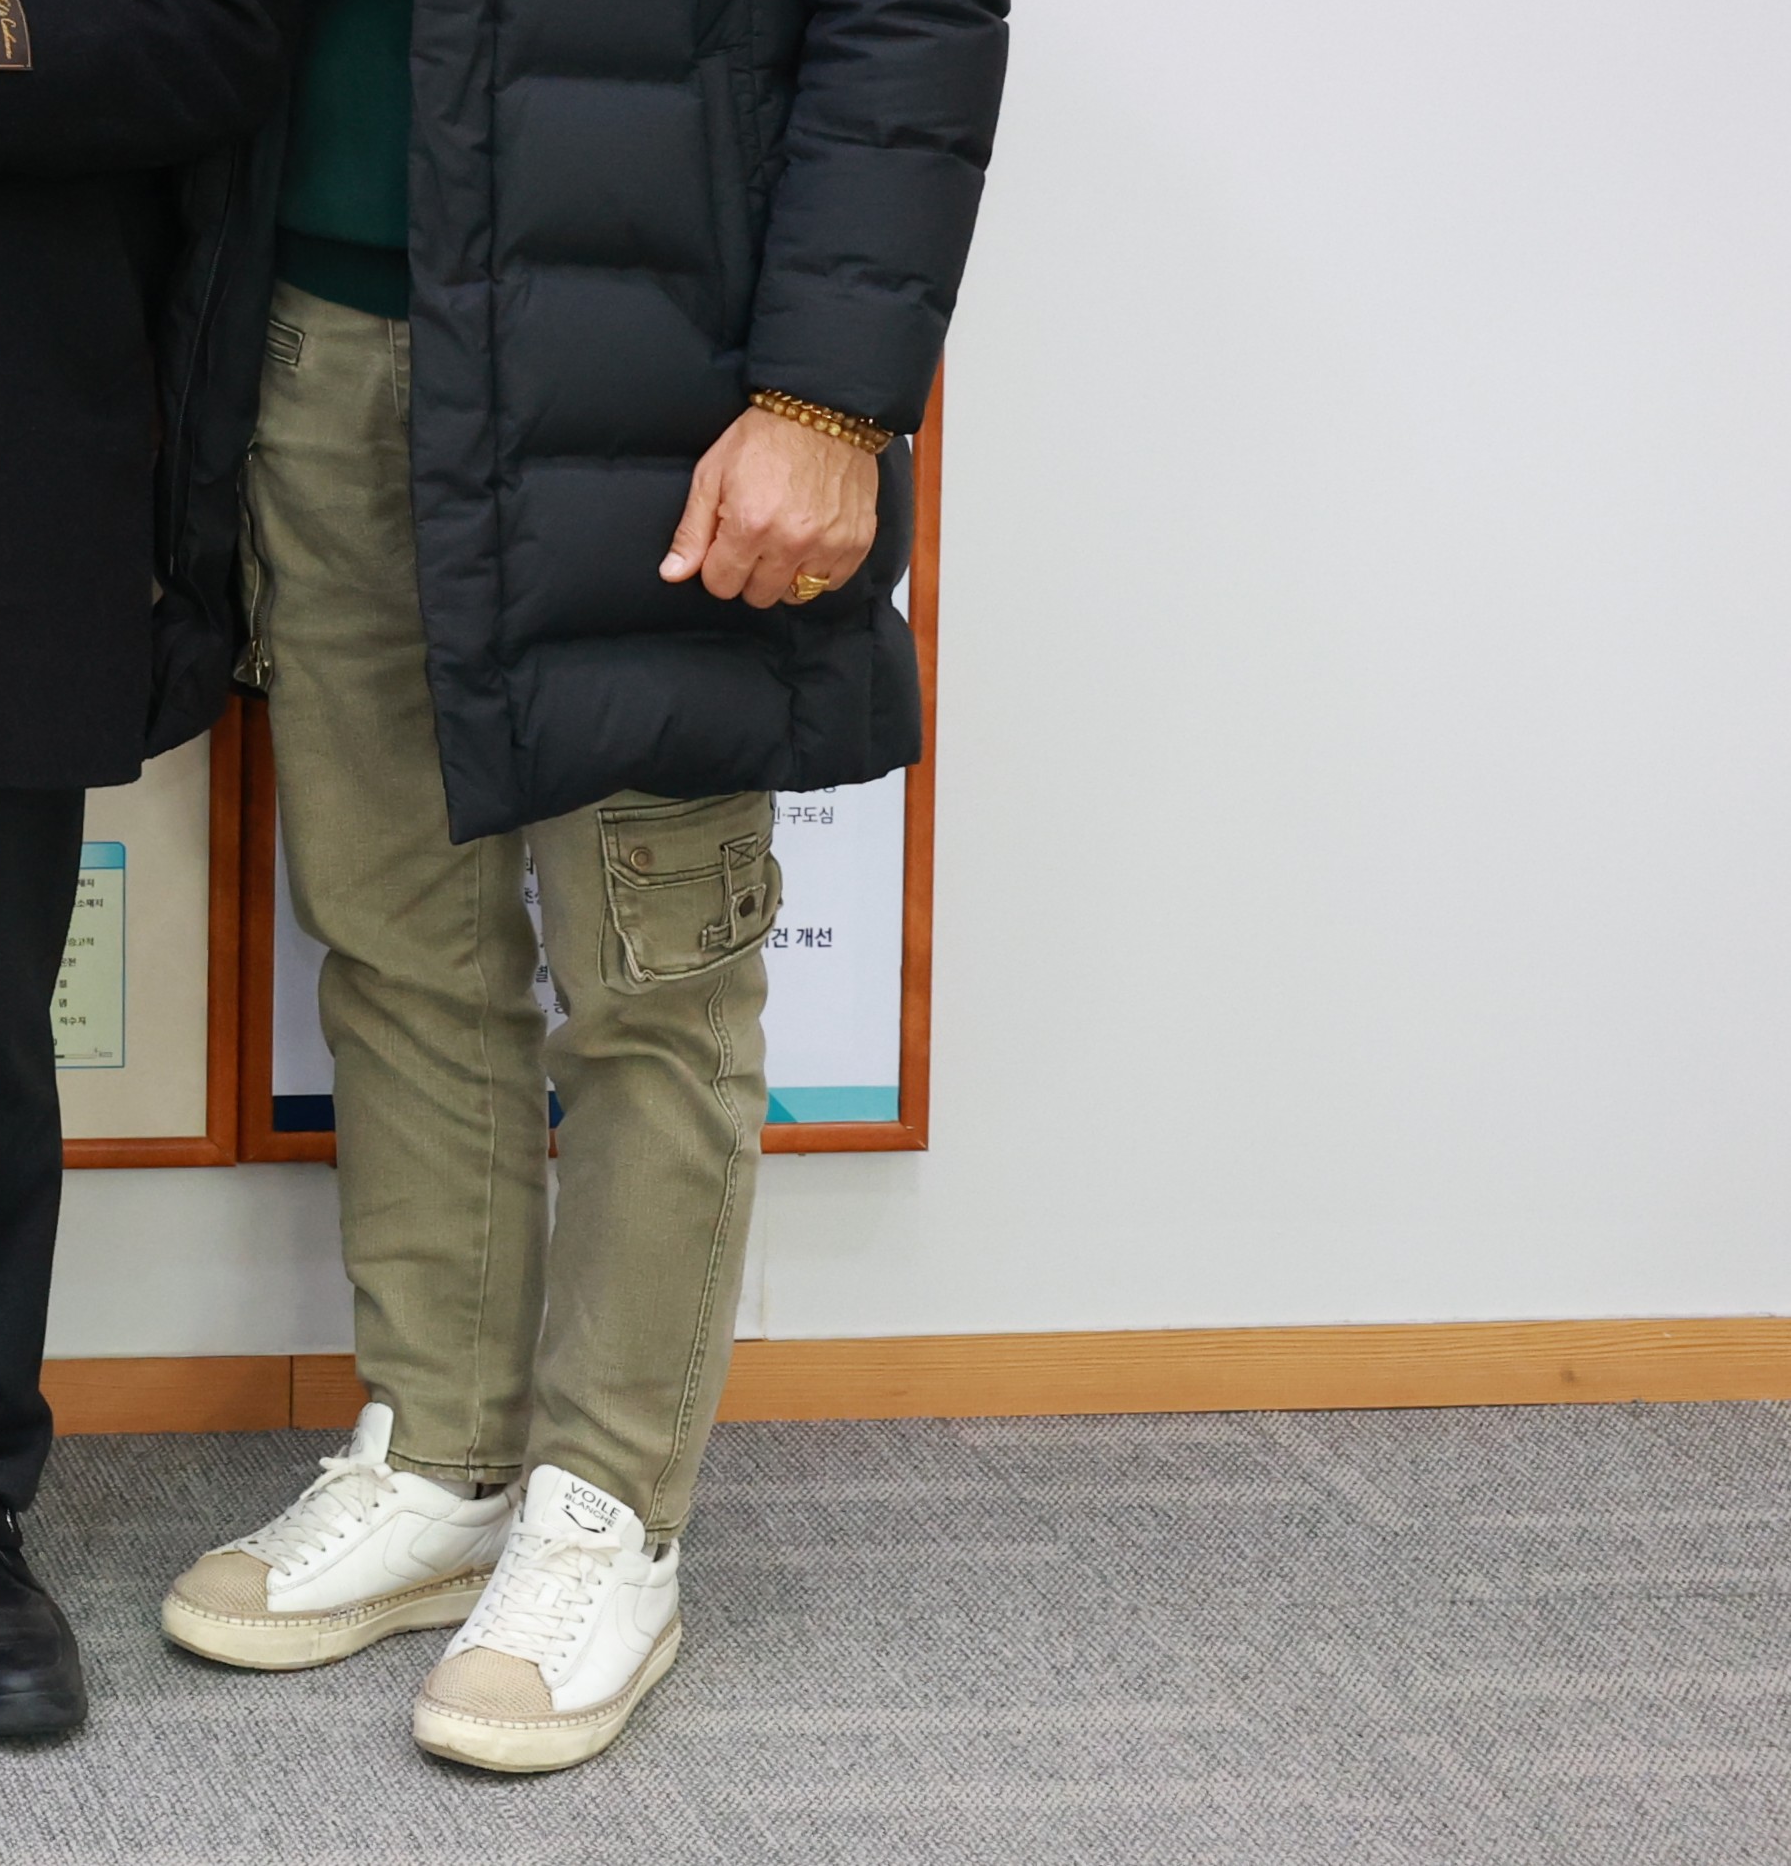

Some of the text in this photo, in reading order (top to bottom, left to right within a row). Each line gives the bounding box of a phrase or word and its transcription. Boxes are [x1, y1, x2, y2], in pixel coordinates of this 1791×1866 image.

[796, 927, 833, 948] 개선
[564, 1492, 615, 1527] BLANCHE
[571, 1481, 621, 1520] VOILE
